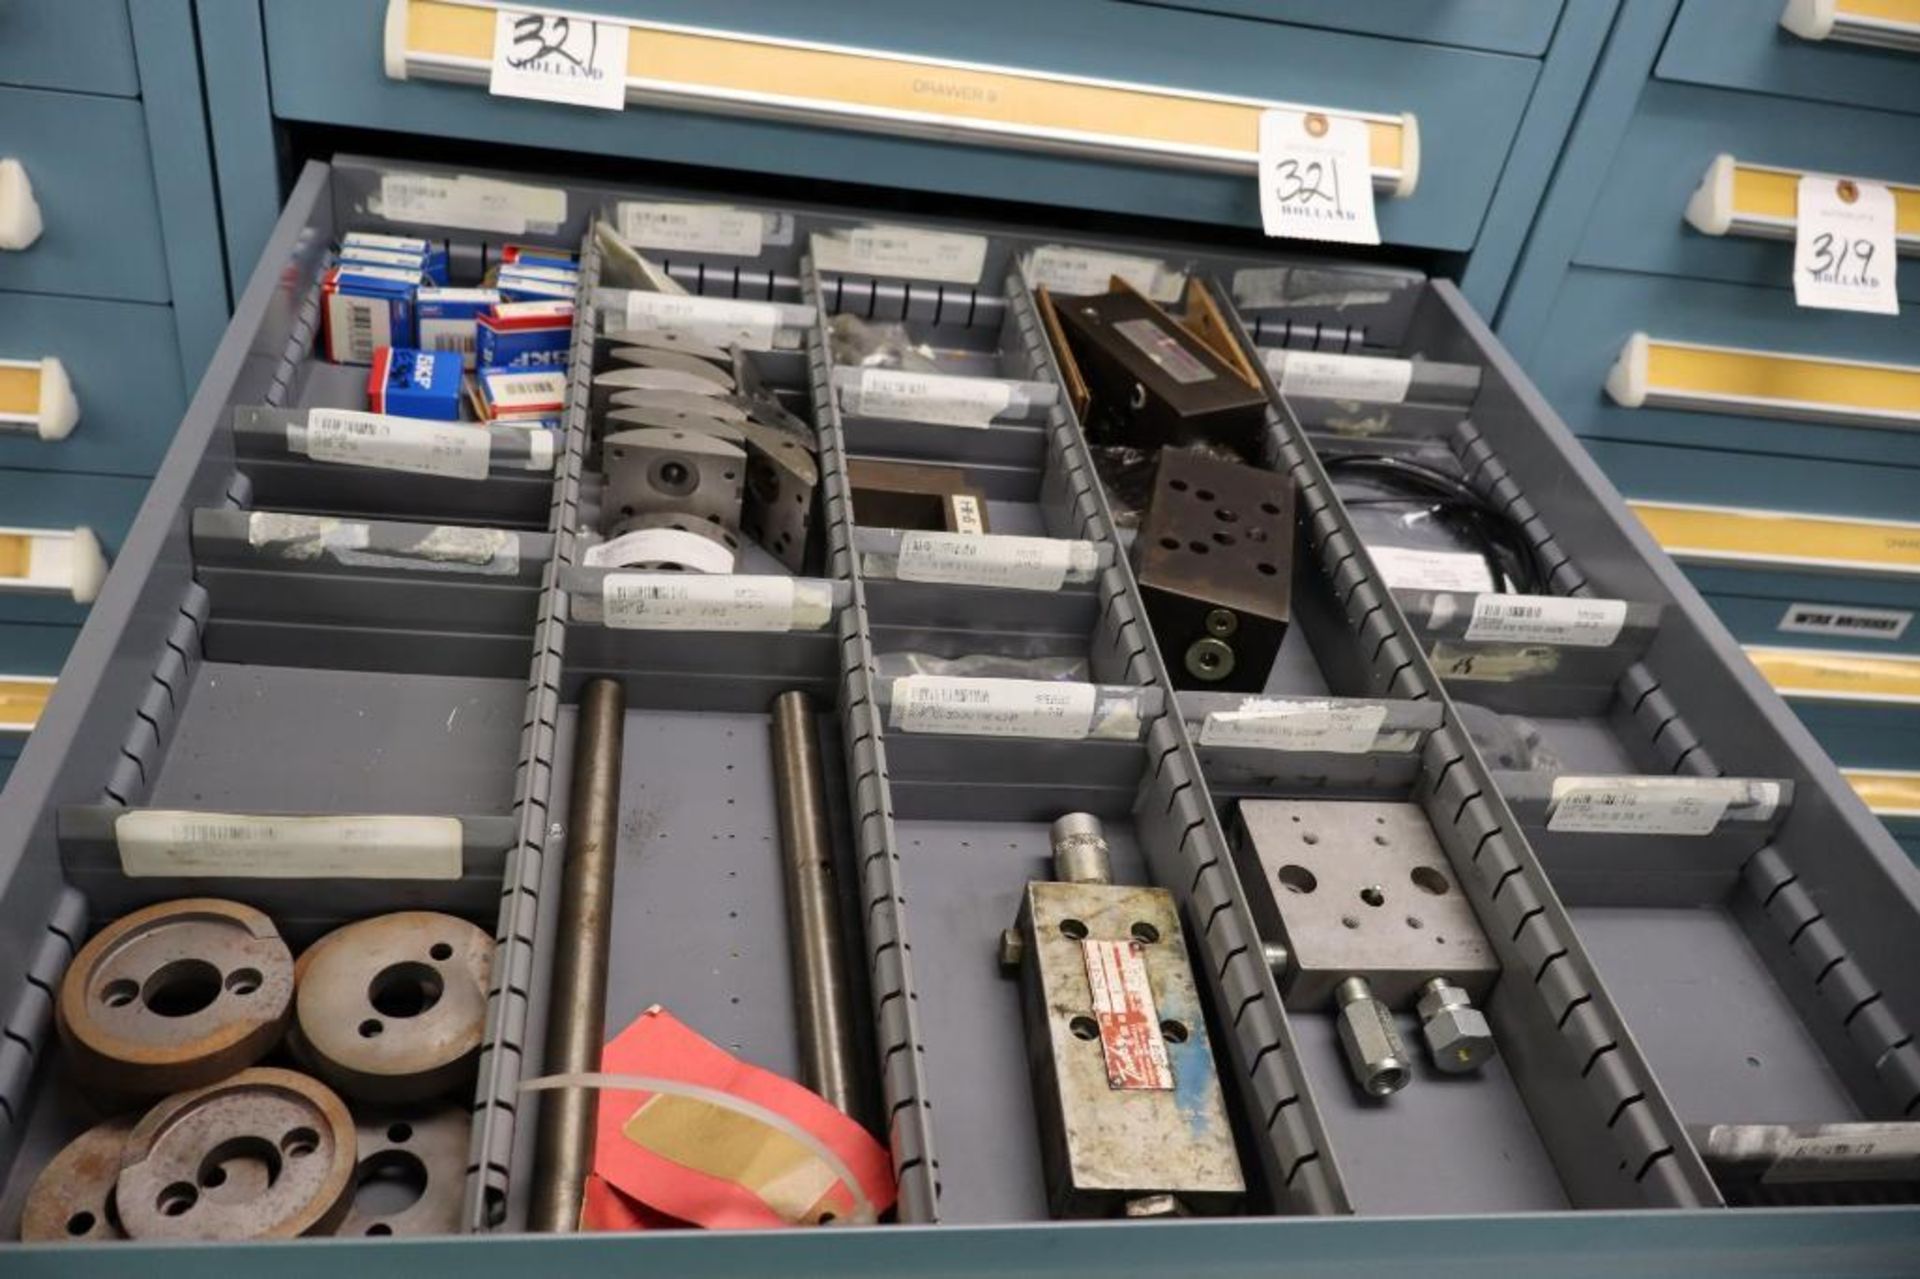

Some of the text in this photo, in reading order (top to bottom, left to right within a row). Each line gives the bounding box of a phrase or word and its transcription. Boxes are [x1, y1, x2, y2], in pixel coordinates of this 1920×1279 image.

[506, 14, 597, 74] 321
[1276, 157, 1342, 214] 321
[1805, 231, 1875, 283] 319
